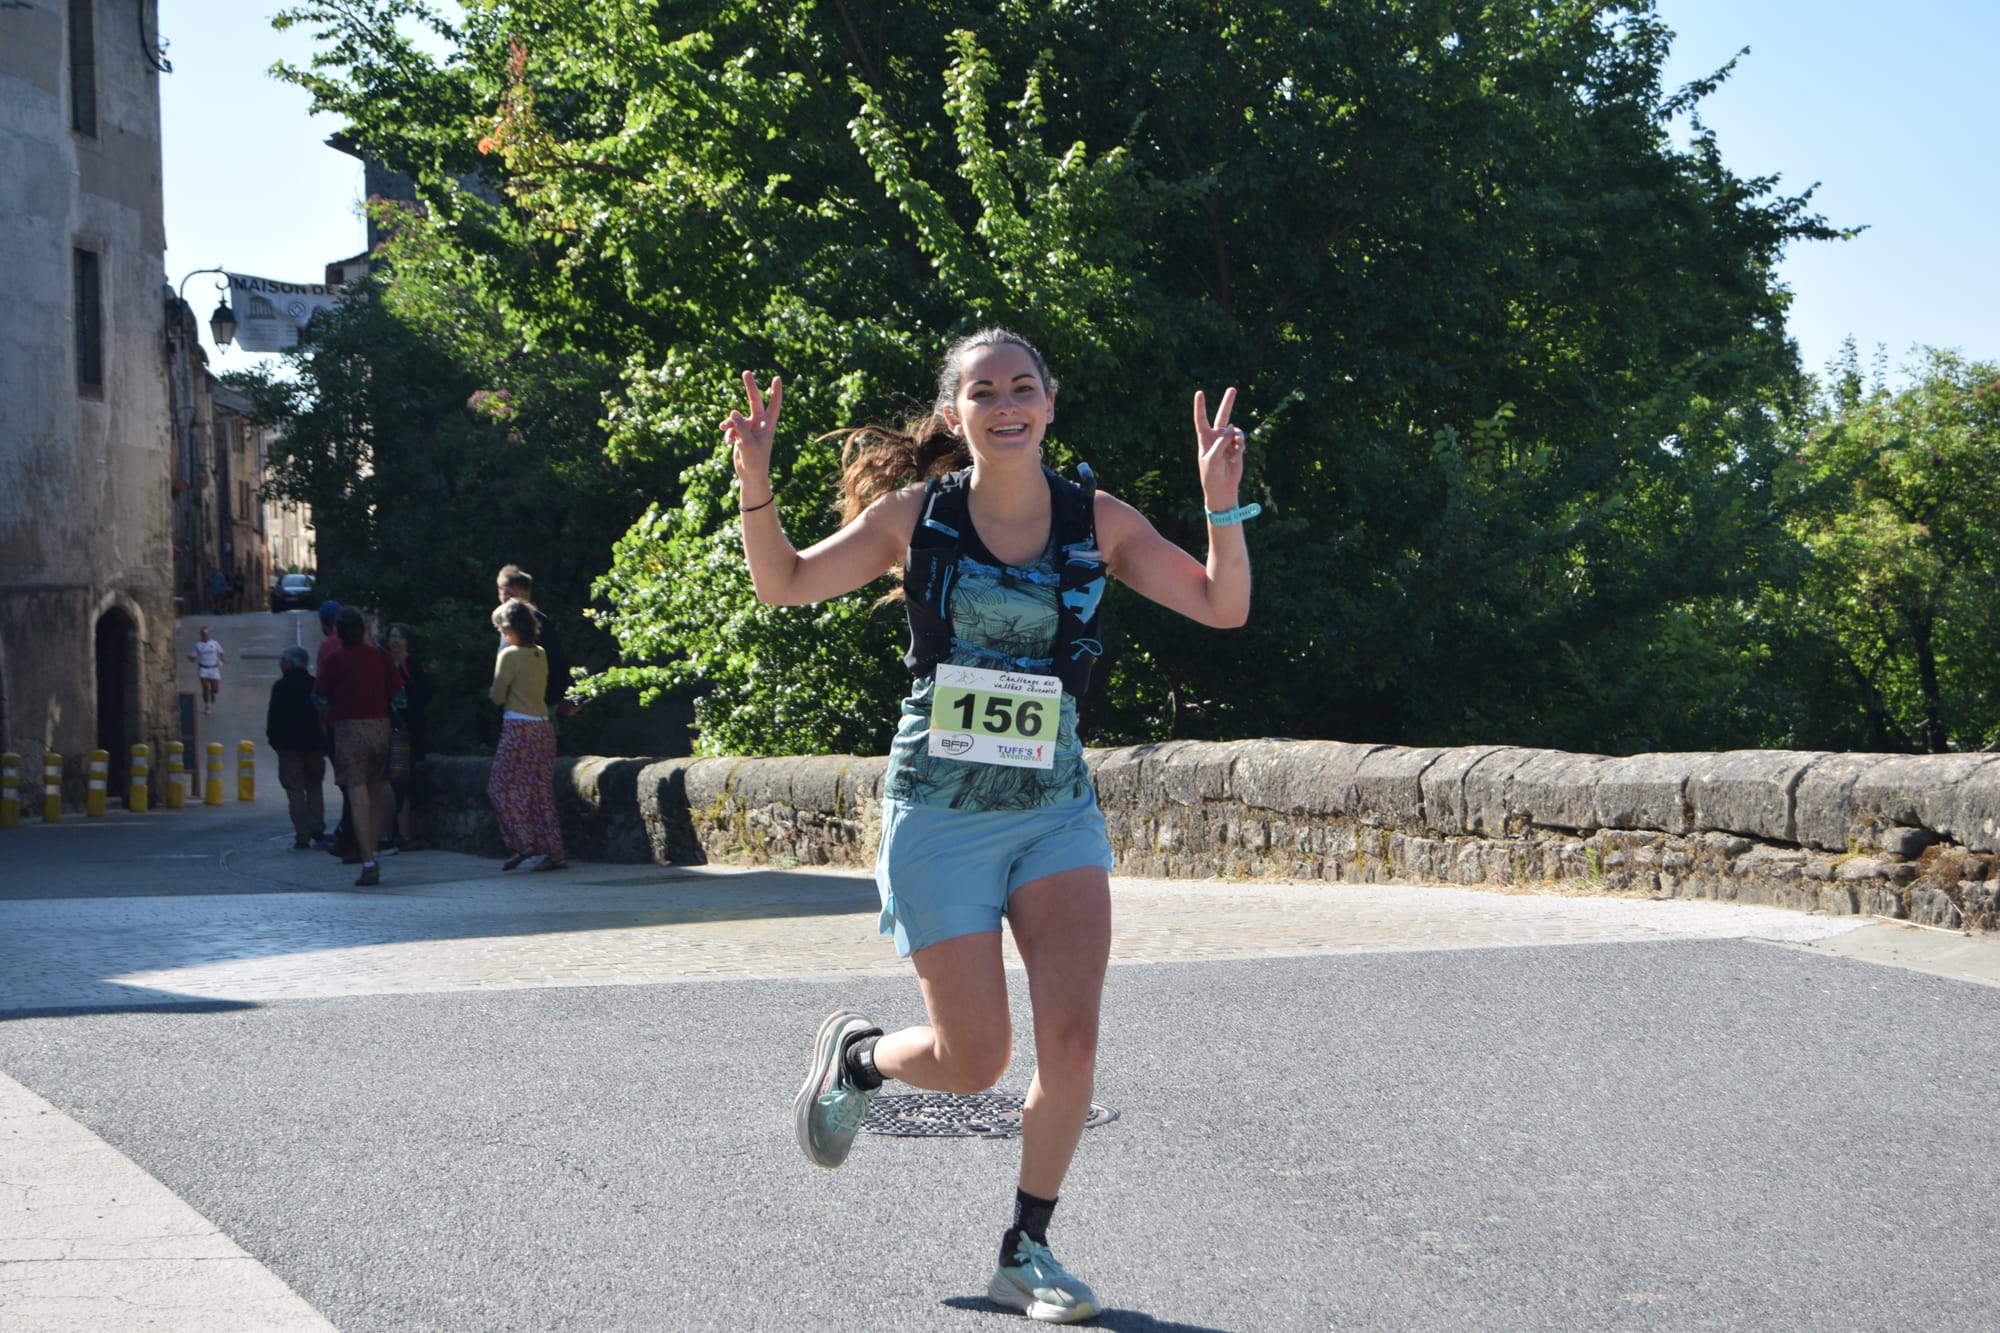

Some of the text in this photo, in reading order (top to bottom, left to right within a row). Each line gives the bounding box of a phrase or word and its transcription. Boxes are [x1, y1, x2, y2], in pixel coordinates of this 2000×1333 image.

[233, 277, 308, 295] MAISON
[999, 674, 1039, 687] Challenge
[953, 693, 1044, 737] 156
[941, 738, 969, 749] BFP
[996, 744, 1033, 756] TUFF'S
